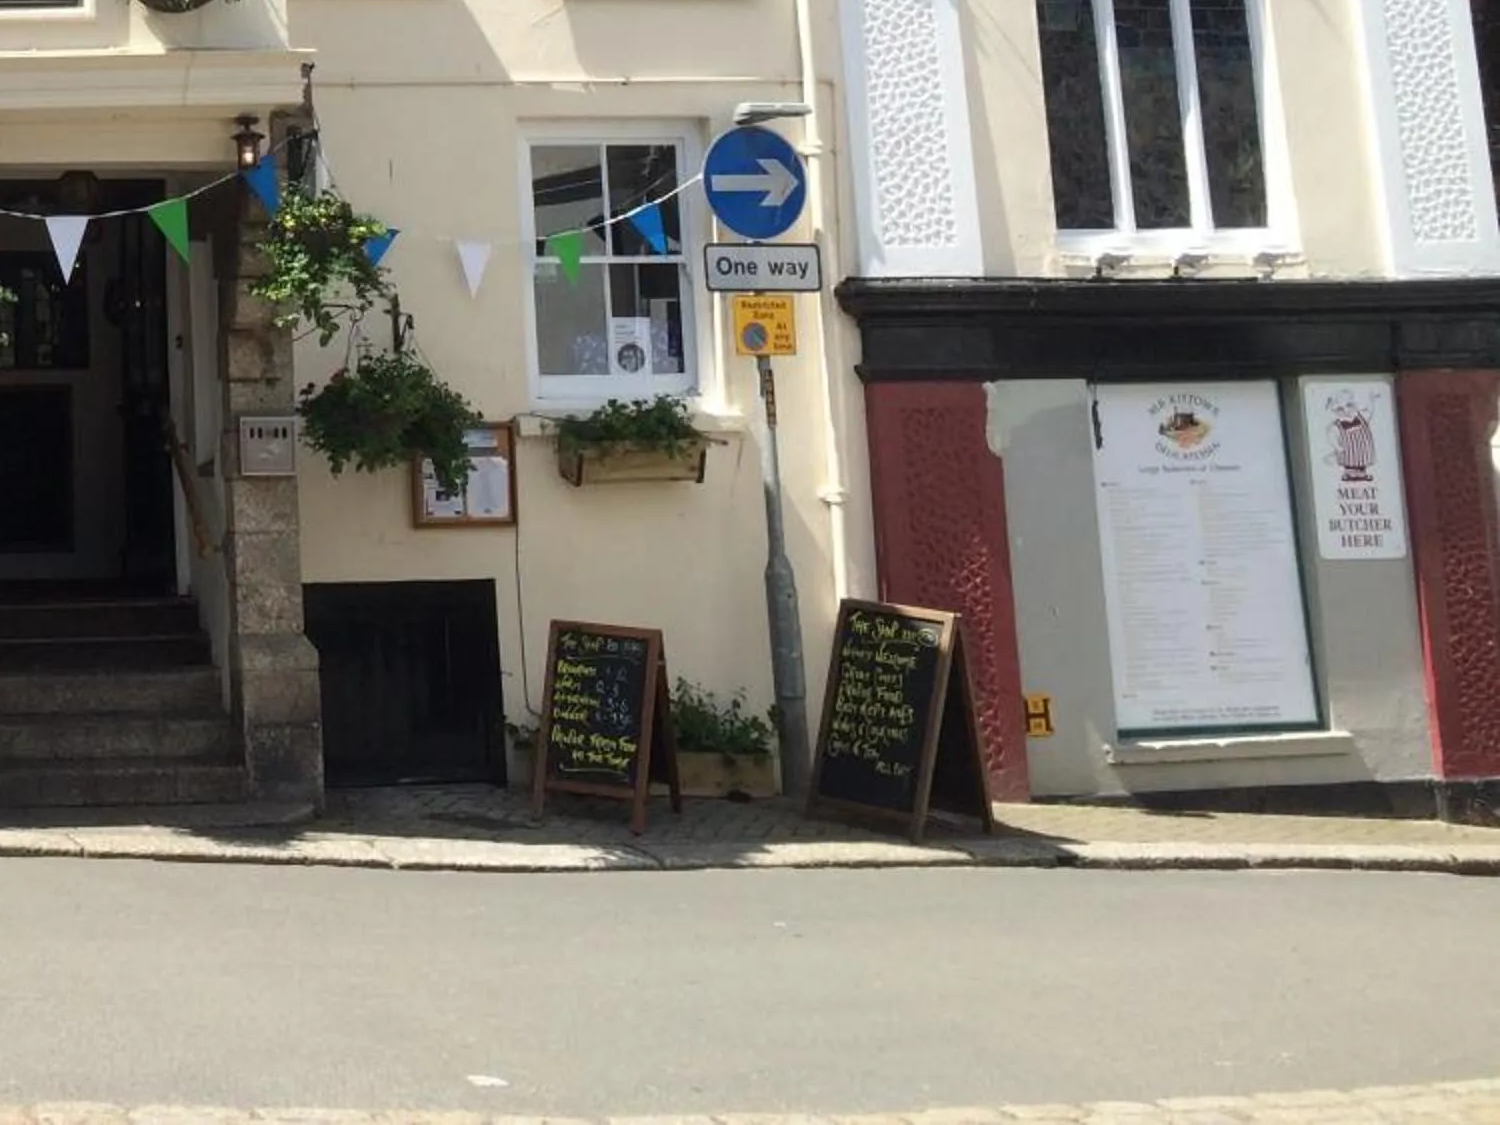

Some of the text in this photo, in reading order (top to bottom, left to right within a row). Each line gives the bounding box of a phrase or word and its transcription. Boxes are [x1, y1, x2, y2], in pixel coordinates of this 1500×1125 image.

[716, 256, 810, 279] One way
[1336, 487, 1381, 501] MEAT
[1337, 502, 1381, 516] YOUR
[1328, 518, 1392, 532] BUTCHER
[1340, 534, 1384, 548] HERE
